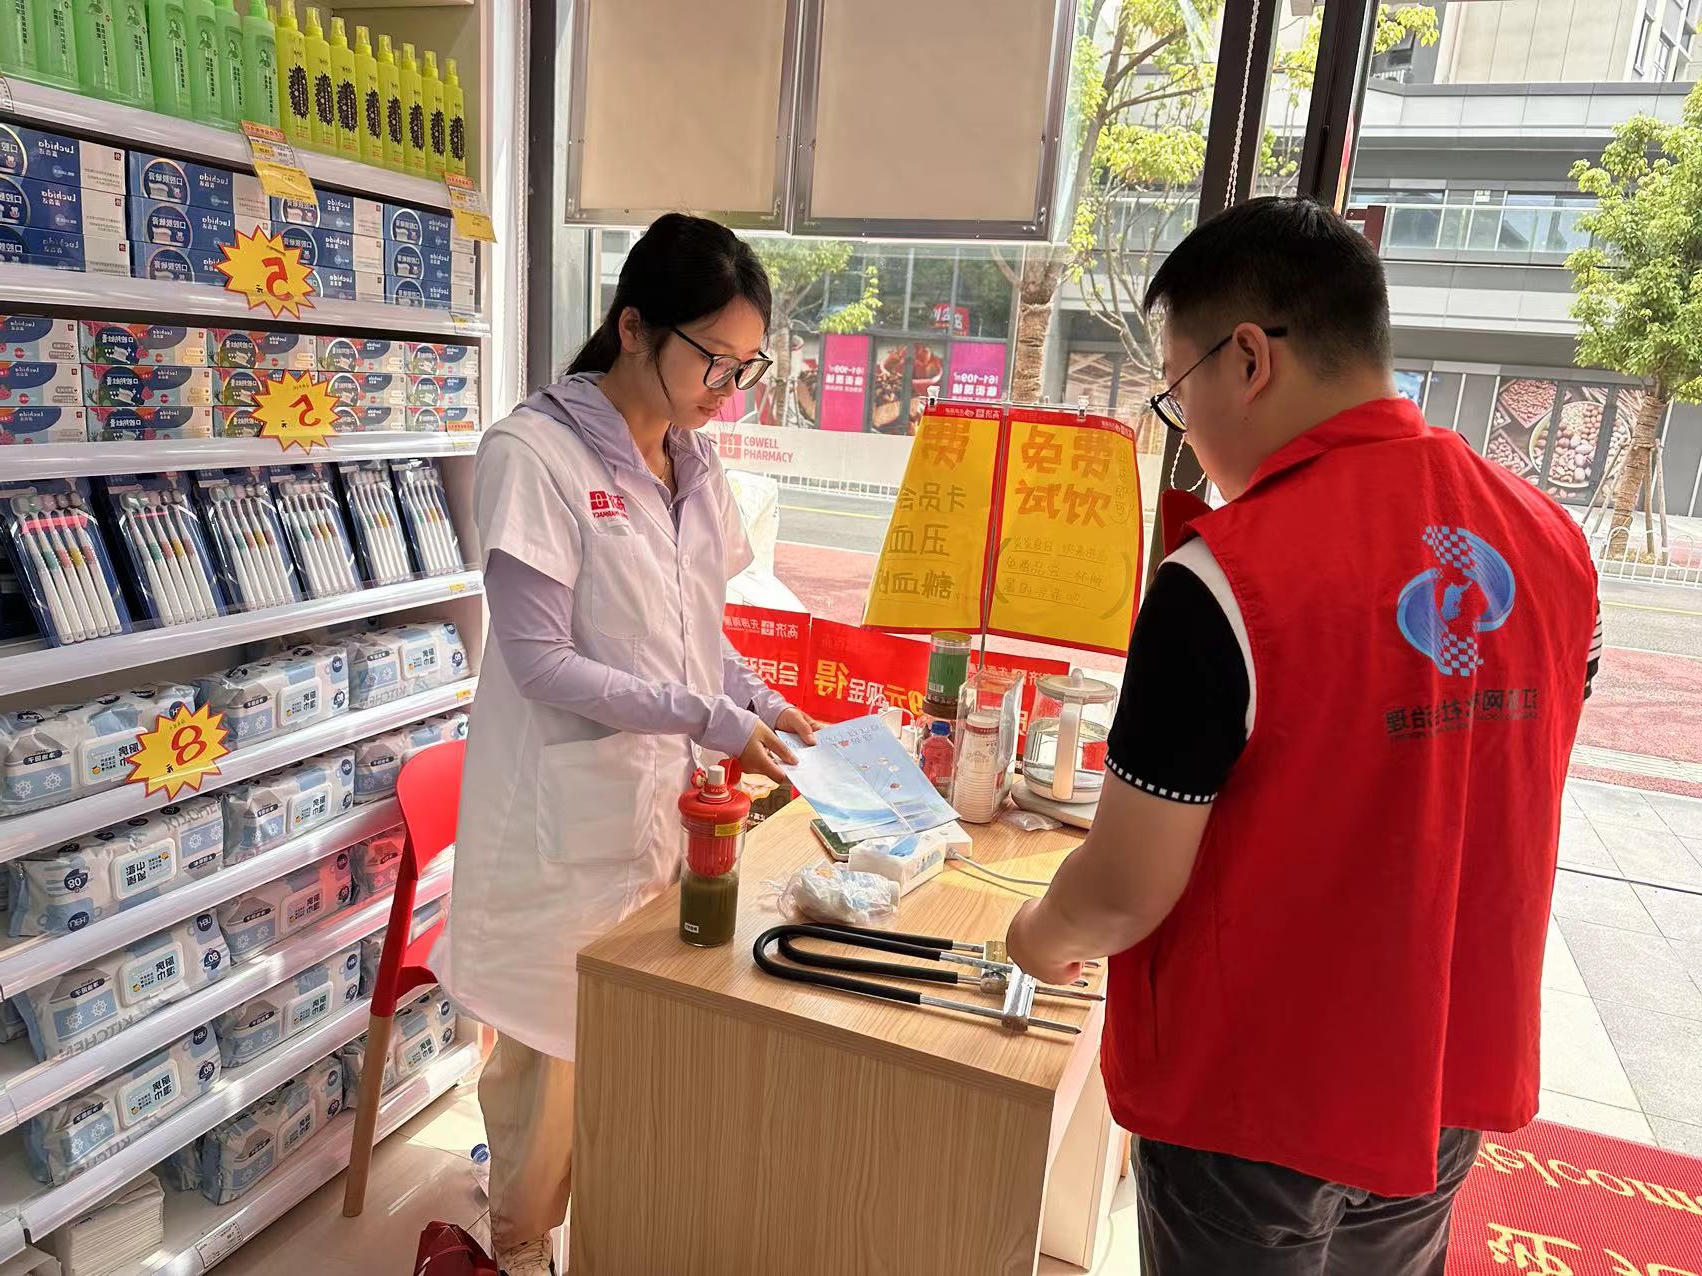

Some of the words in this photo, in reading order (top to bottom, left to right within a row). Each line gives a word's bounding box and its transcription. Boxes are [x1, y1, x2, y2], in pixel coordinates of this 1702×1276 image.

[744, 436, 779, 449] COWELL
[744, 449, 793, 463] PHARMACY
[1021, 425, 1113, 481] 免费
[1015, 478, 1112, 528] 试饮
[887, 524, 950, 557] 血压
